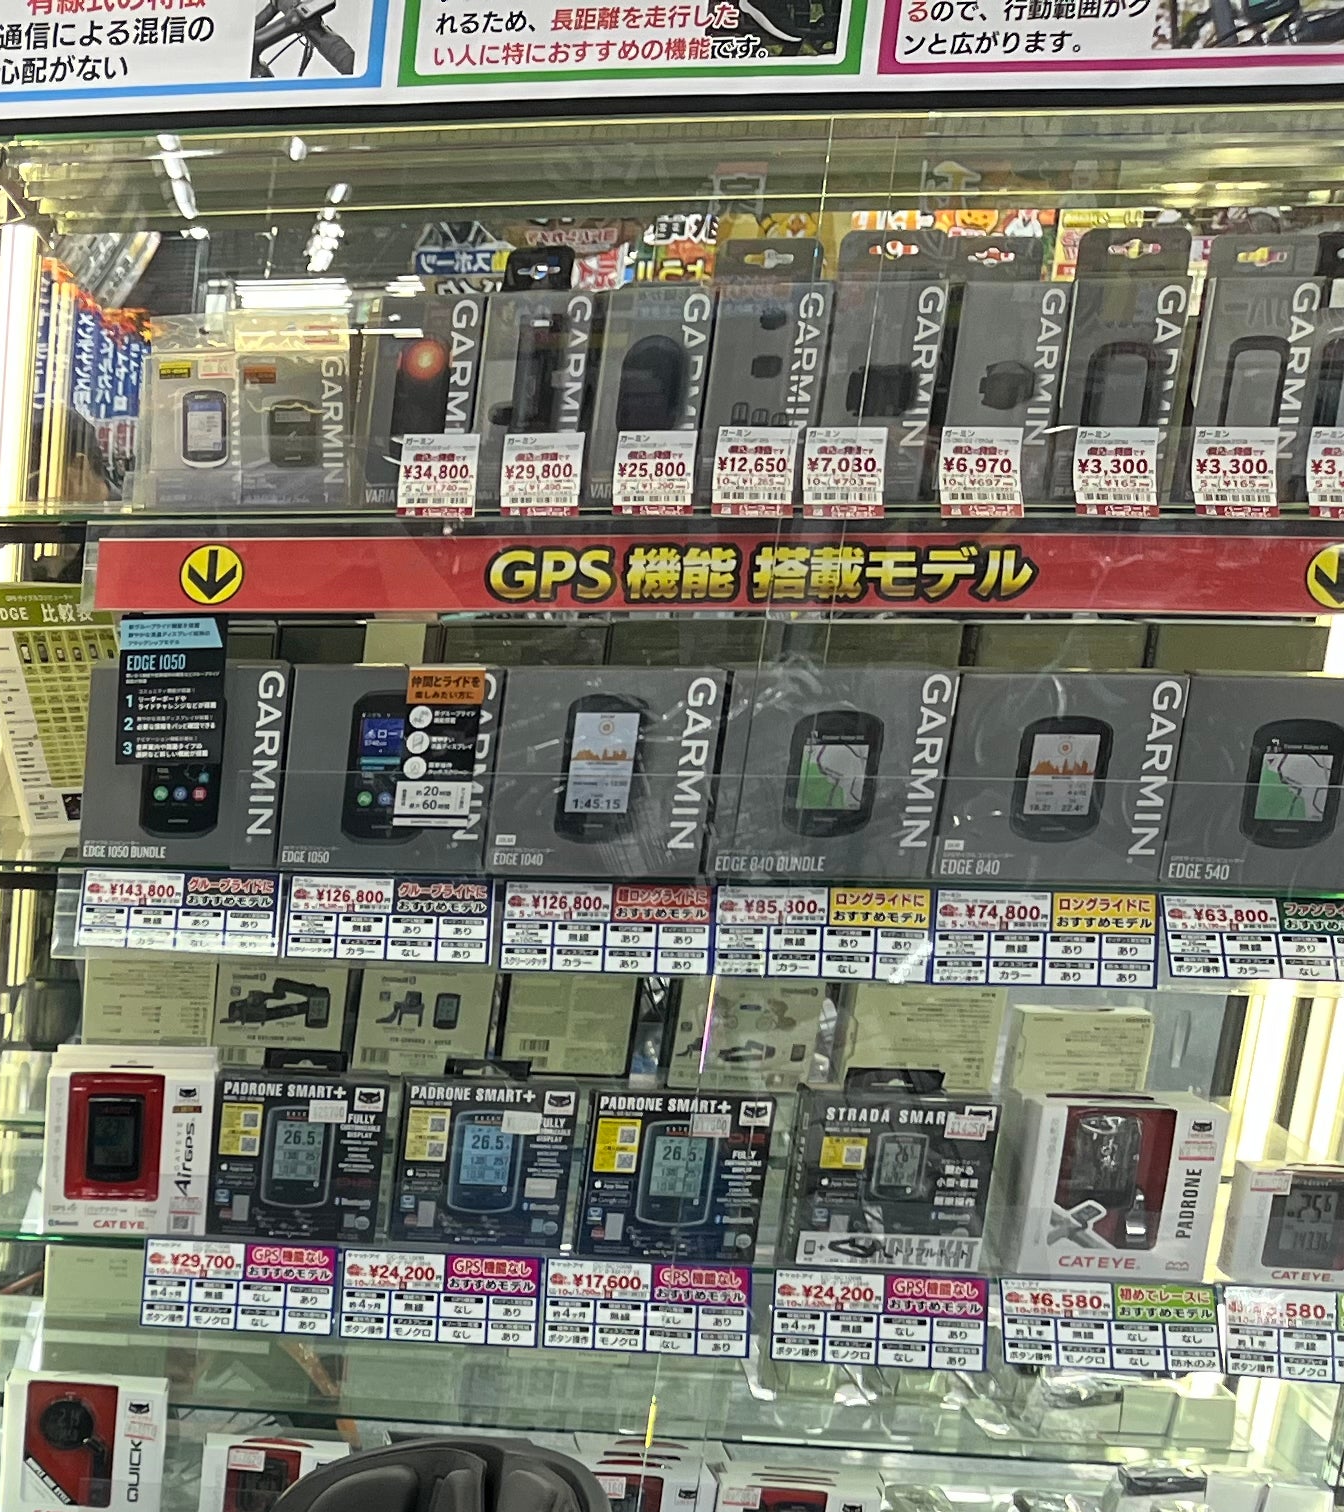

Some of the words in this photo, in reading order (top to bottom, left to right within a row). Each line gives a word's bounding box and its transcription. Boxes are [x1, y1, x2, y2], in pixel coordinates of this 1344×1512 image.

[903, 28, 1084, 57] ンと広がります。
[1023, 288, 1068, 446] GARMIN
[488, 547, 613, 601] GPS
[626, 546, 737, 600] 機能
[753, 546, 1035, 601] 搭載モデル
[126, 654, 156, 671] EDGE
[159, 653, 187, 670] 1050
[244, 669, 287, 837] GARMIN
[899, 673, 952, 851] GARMIN
[667, 677, 718, 851] GARMIN
[1128, 679, 1183, 857] GARMIN
[130, 845, 166, 860] BUNDLE
[940, 858, 974, 876] EDGE
[976, 859, 1001, 876] 840
[1168, 862, 1202, 880] EDGE
[1204, 863, 1231, 881] 540
[110, 882, 176, 898] ¥143,800
[317, 888, 385, 904] ¥126,800
[532, 895, 603, 911] ¥126,800
[835, 892, 926, 908] ロングライドに
[965, 902, 1041, 921] ¥74,800
[1058, 897, 1152, 913] ロングライドに
[833, 910, 927, 924] おすすめモデル
[1056, 916, 1154, 930] おすすめモデル
[1193, 907, 1269, 923] ¥63,800
[223, 1081, 283, 1098] PADRONE
[411, 1084, 471, 1101] PADRONE
[599, 1095, 663, 1113] PADRONE
[826, 1106, 891, 1122] STRADA
[1175, 1168, 1203, 1239] PADRONE
[127, 1439, 142, 1502] QUICK
